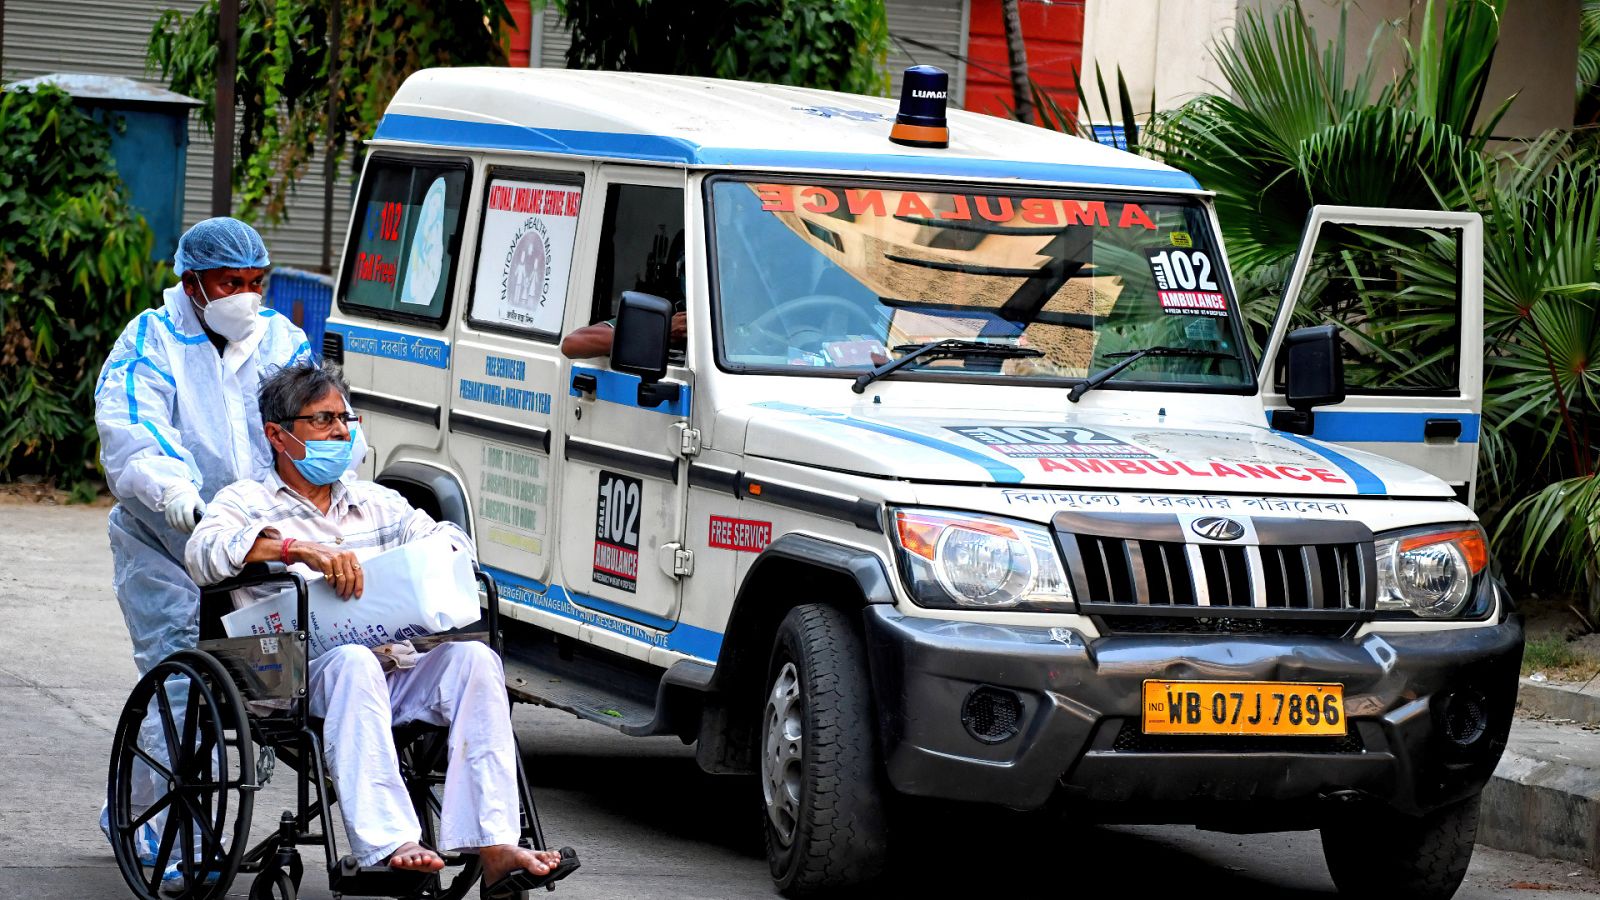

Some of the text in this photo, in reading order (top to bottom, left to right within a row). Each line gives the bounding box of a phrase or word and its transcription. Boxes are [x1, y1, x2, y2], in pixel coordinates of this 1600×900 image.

[912, 89, 947, 99] LUMAX
[381, 201, 402, 240] 102
[501, 227, 523, 300] NATIONAL
[524, 217, 547, 239] HEALTH
[540, 237, 552, 307] MISSION
[1150, 250, 1218, 291] CALL 102
[1161, 292, 1226, 309] AMBULANCE
[957, 427, 1119, 444] 102
[999, 444, 1146, 454] AMBULANCE
[1037, 457, 1347, 484] AMBULANCE
[600, 477, 640, 546] 102
[1131, 495, 1231, 509] সরকারি
[597, 498, 606, 538] CALL
[711, 520, 768, 549] FREE SERVICE
[595, 543, 638, 577] AMBULANCE
[498, 585, 532, 602] MERGENCY
[532, 593, 579, 616] MANAGEMENT
[579, 611, 595, 622] AND
[595, 614, 631, 635] RESEARCH
[376, 624, 389, 638] CT
[1148, 702, 1165, 712] IND
[1167, 691, 1201, 725] WB
[1272, 693, 1340, 726] 7896
